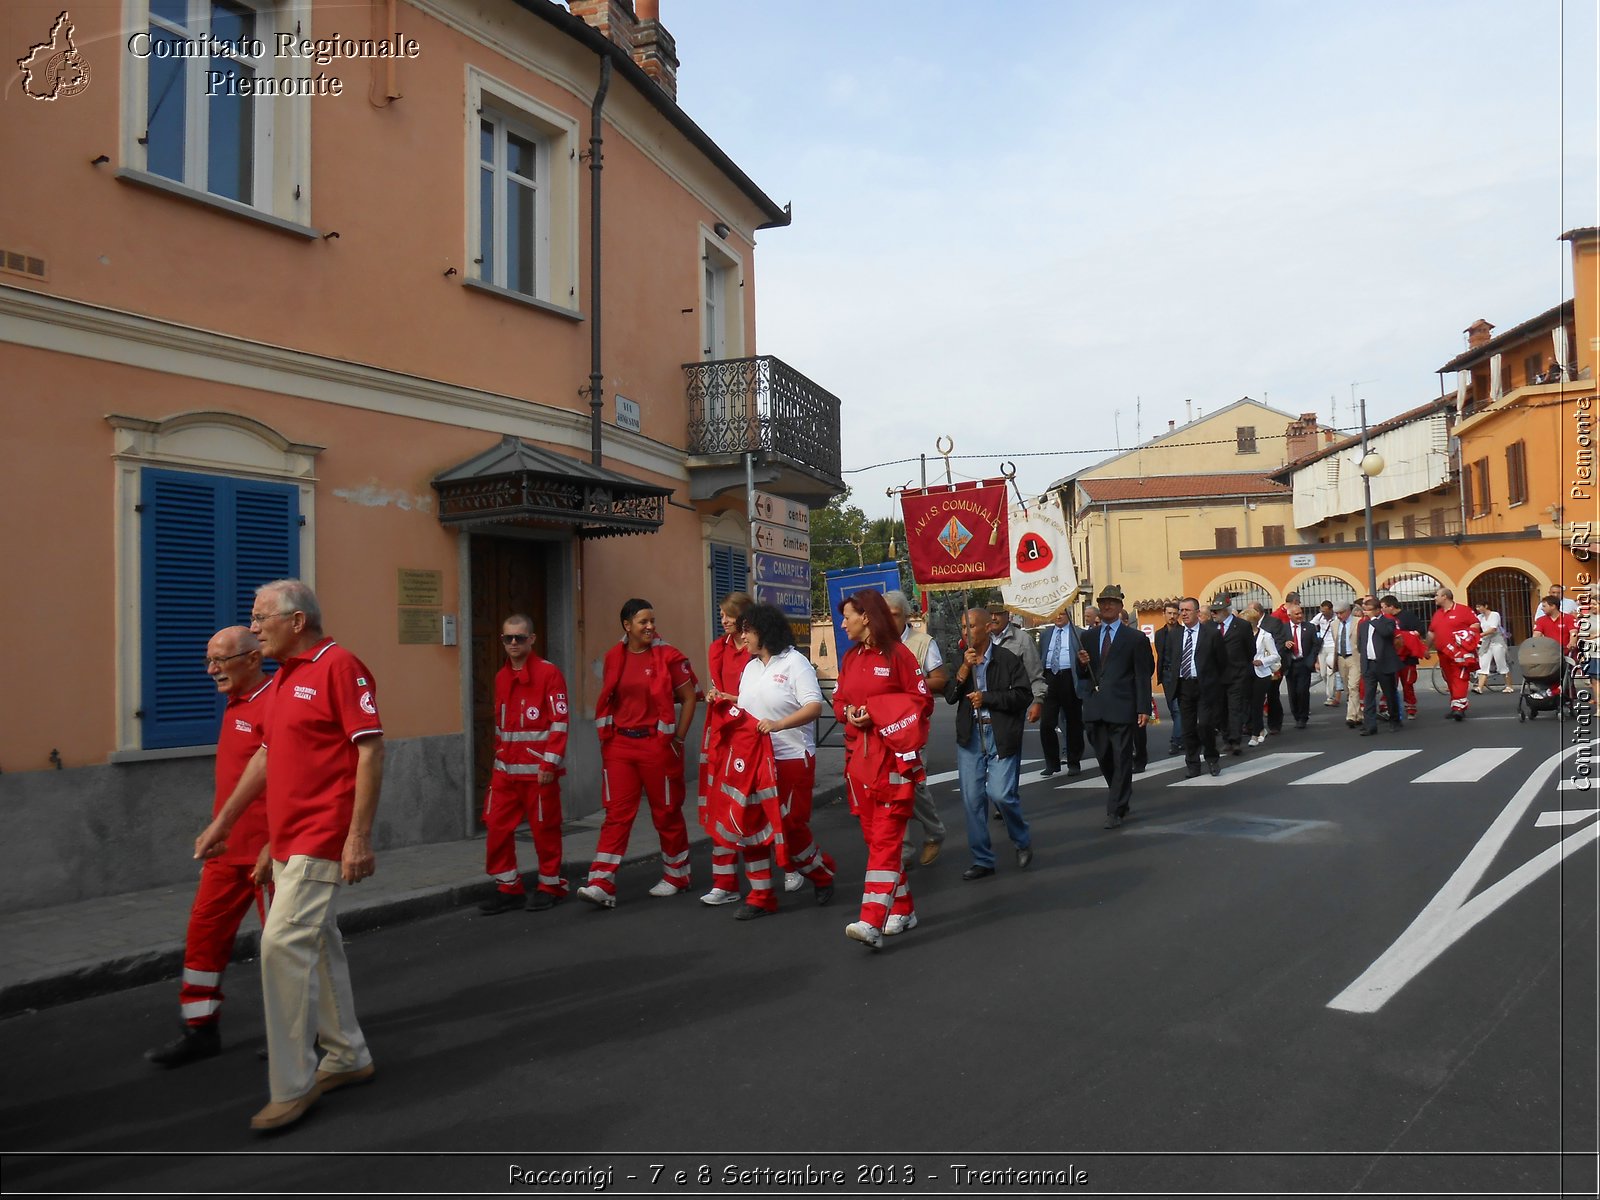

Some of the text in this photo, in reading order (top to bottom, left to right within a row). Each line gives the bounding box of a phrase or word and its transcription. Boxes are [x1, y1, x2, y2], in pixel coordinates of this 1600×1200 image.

[788, 510, 808, 523] centro
[942, 499, 1001, 529] COMUNALE
[783, 537, 809, 553] cimitero
[773, 561, 804, 578] CANAPILE
[931, 562, 986, 576] RACCONIGI
[1020, 575, 1060, 592] GRUPPO DI
[776, 592, 805, 607] TAGLIATA
[1014, 582, 1071, 605] RACCONIGI
